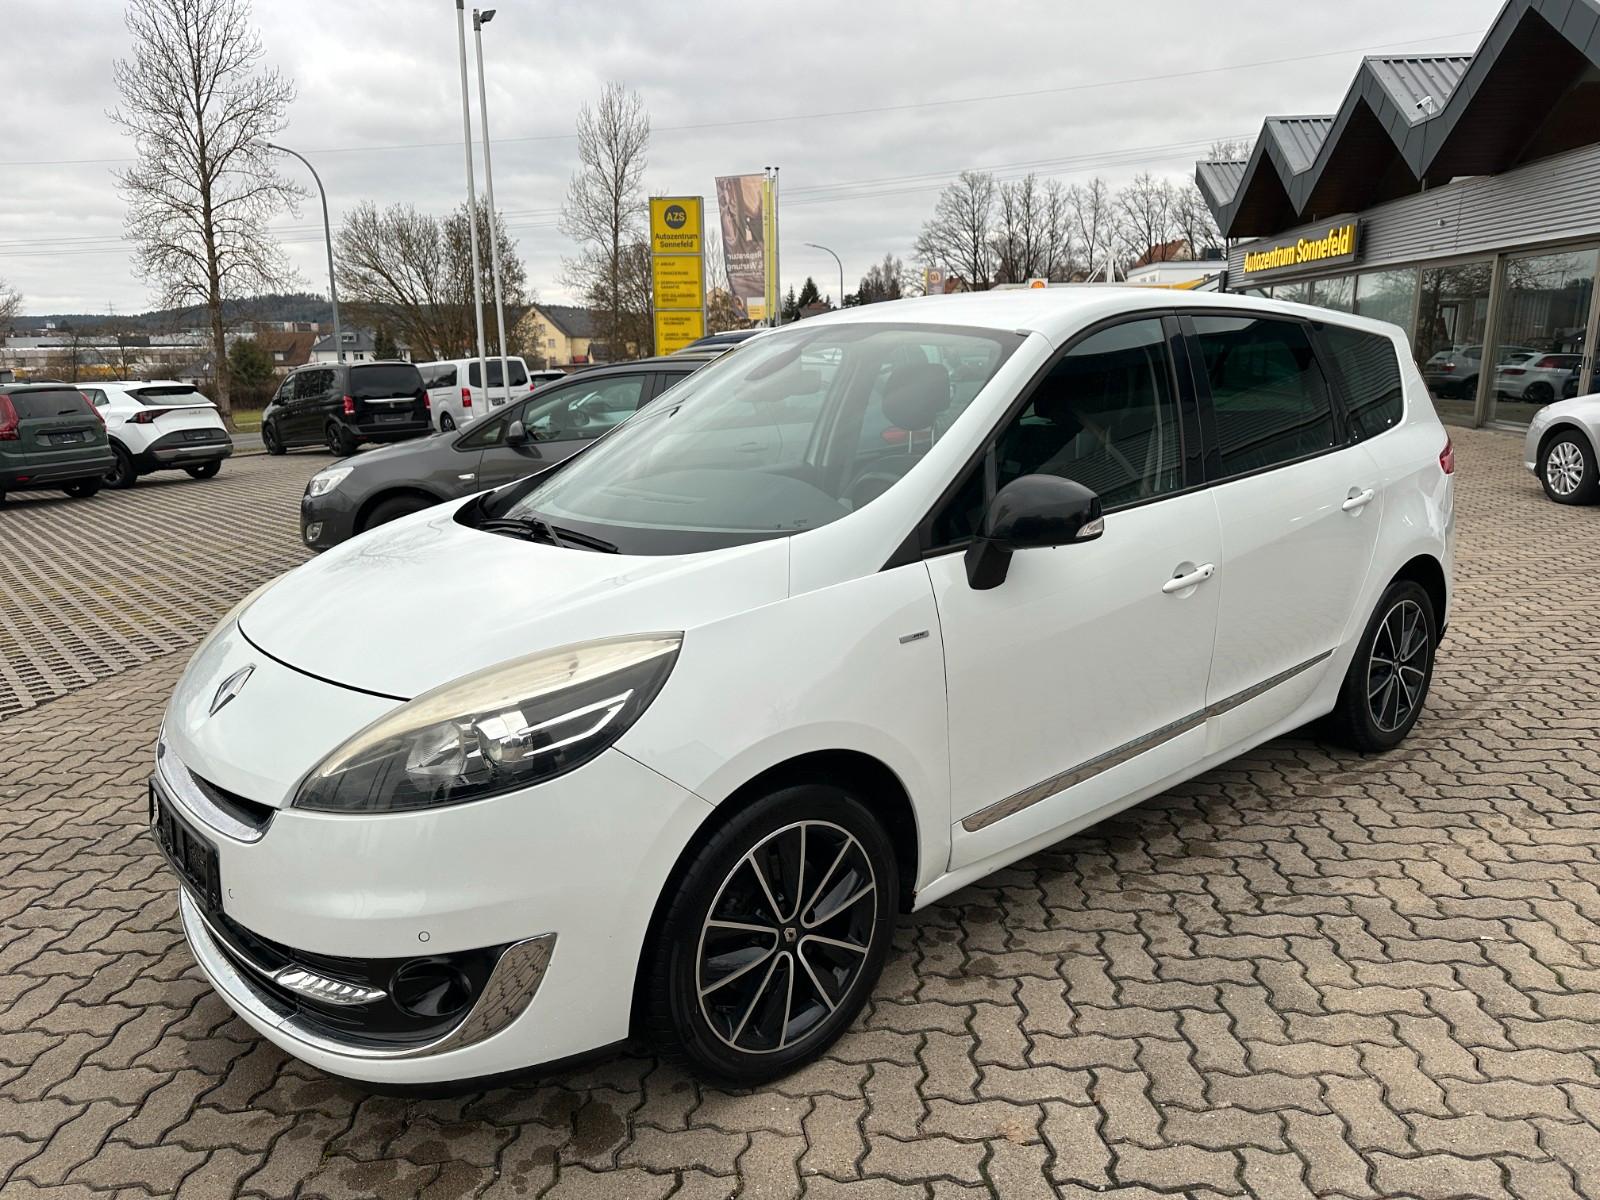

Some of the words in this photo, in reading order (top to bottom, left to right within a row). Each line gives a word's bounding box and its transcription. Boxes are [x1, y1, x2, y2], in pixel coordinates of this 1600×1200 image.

[666, 211, 686, 222] AZS
[660, 240, 694, 248] Sonnefeld
[1243, 247, 1295, 273] Autozentrum
[1297, 225, 1351, 263] Sonnefeld
